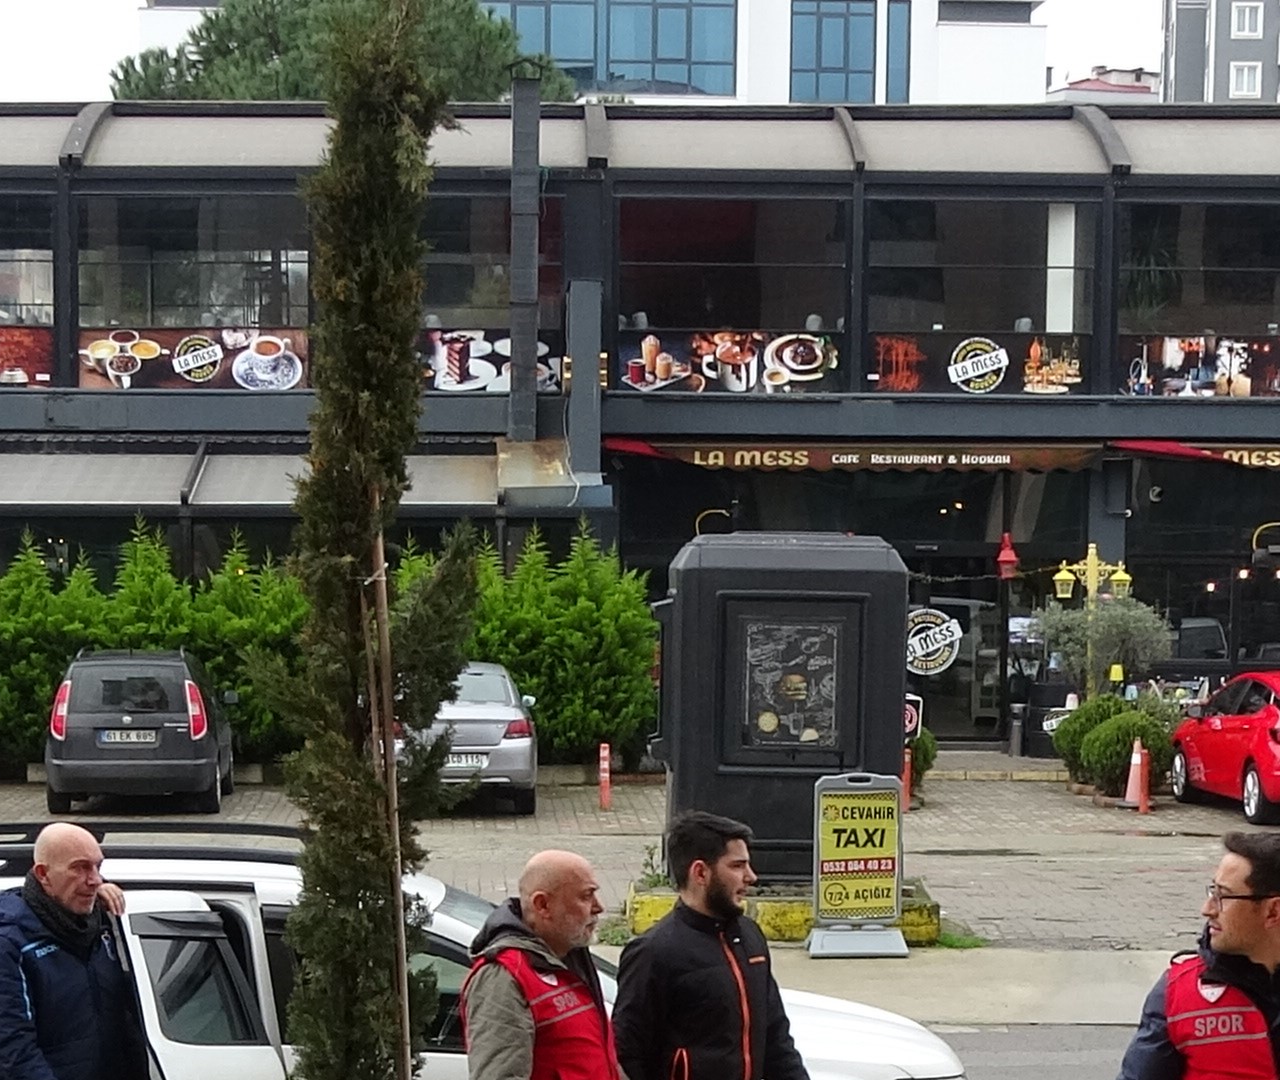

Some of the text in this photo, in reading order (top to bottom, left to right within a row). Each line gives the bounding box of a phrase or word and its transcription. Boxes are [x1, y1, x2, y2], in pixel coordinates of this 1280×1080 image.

[178, 348, 218, 369] LA MESS
[954, 365, 969, 378] LA
[971, 353, 1002, 373] MESS
[694, 450, 724, 466] LA
[734, 450, 809, 466] MESS
[871, 453, 944, 465] RESTAURANT
[948, 454, 957, 464] &
[962, 453, 1011, 465] HOOKAH
[919, 625, 954, 650] MESS
[832, 827, 886, 848] TAXI
[828, 891, 850, 901] 7/24
[1194, 1014, 1245, 1037] SPOR
